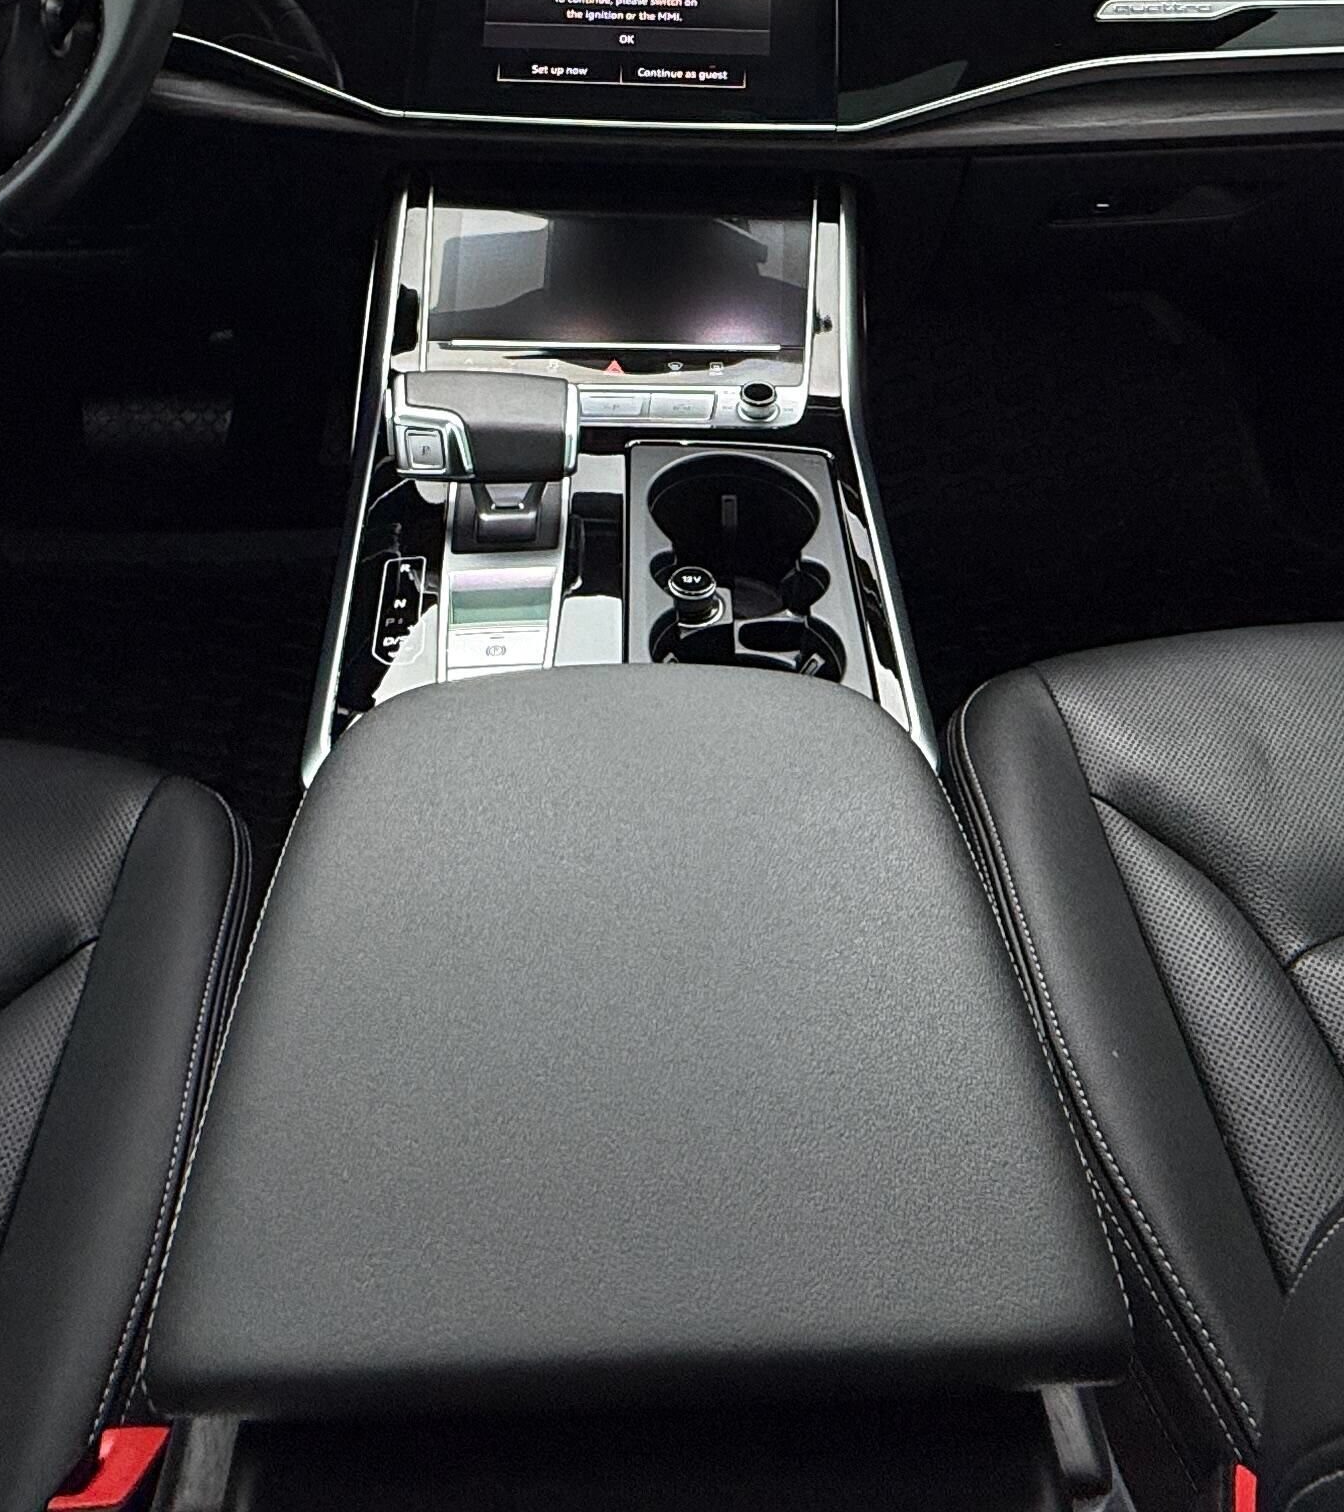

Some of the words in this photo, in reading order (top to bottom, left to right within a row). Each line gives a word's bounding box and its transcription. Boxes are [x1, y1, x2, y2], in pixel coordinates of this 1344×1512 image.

[684, 0, 698, 7] on
[1113, 3, 1213, 15] quattro
[566, 9, 583, 19] the
[585, 10, 624, 22] ignition
[625, 12, 637, 21] or
[638, 11, 656, 21] the
[619, 34, 635, 45] OK
[531, 64, 549, 75] Set
[551, 67, 564, 77] up
[565, 66, 588, 76] now
[637, 67, 683, 79] Continue
[685, 70, 697, 79] as
[698, 69, 728, 82] guest
[394, 599, 407, 609] N
